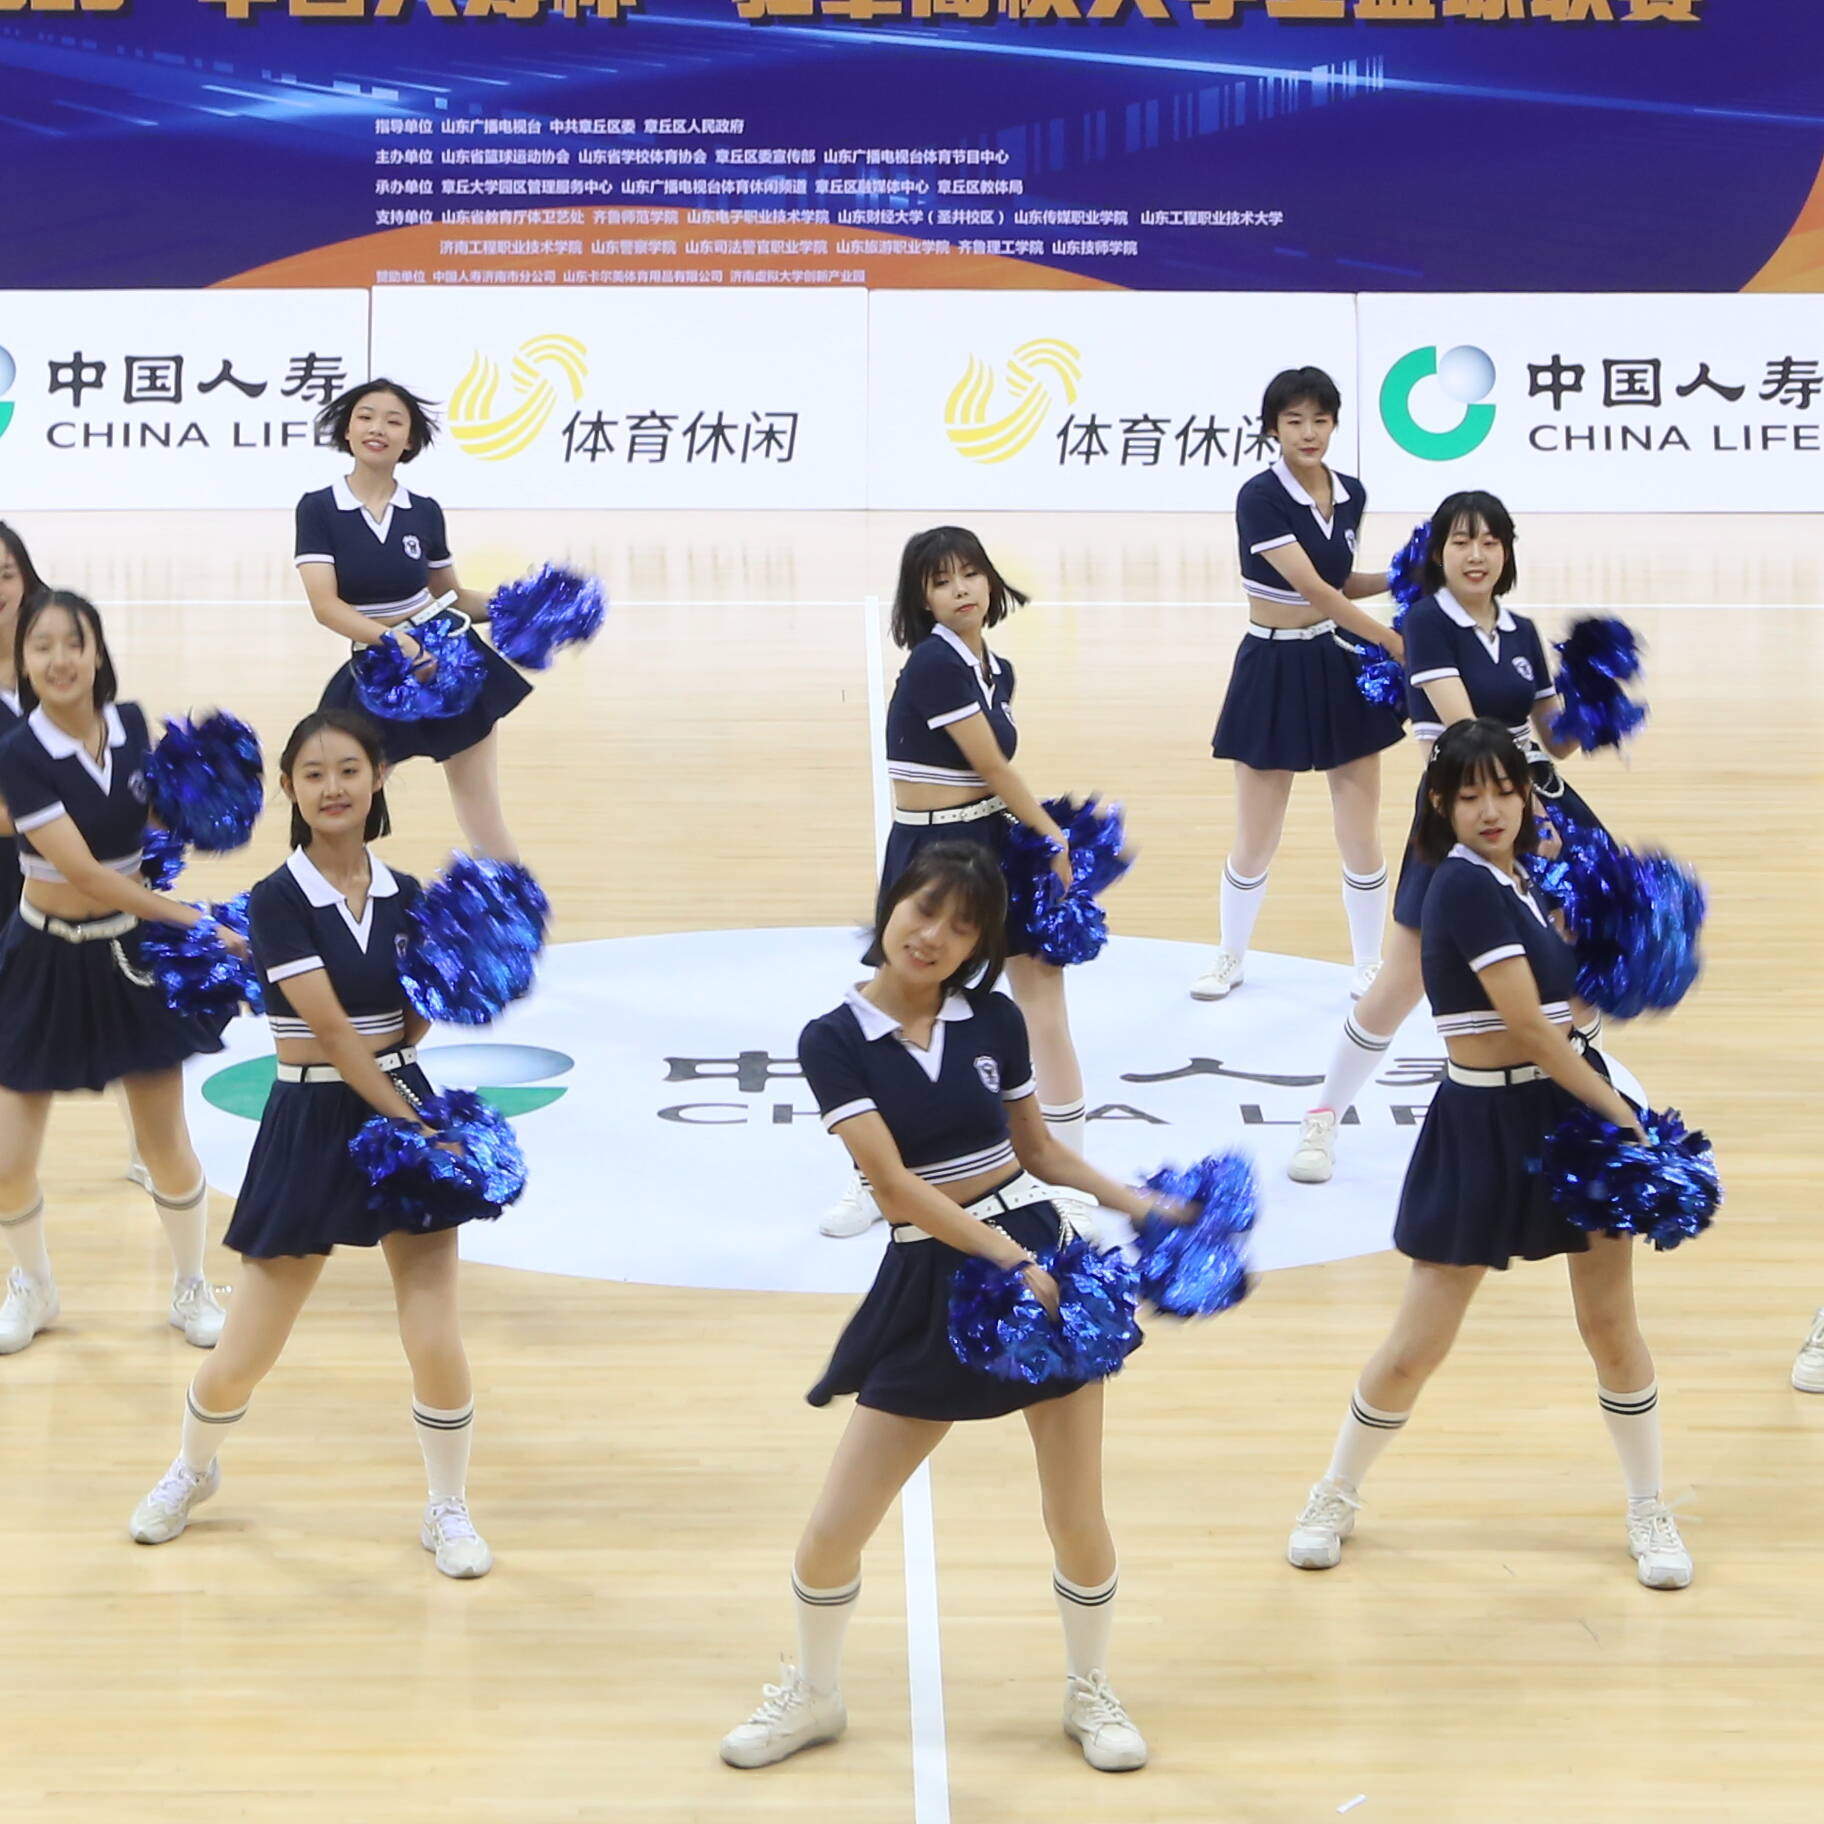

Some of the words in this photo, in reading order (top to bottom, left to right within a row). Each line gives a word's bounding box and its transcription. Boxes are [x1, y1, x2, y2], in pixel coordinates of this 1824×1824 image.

[375, 117, 434, 135] 指导单位
[441, 117, 542, 135] 山东广播电视台
[550, 117, 636, 135] 中共章丘区委
[643, 117, 745, 135] 章丘区人民政府
[375, 148, 434, 165] 主办单位
[441, 148, 570, 165] 山东省篮球运动协会
[578, 148, 707, 165] 山东省学校体育协会
[715, 148, 816, 165] 章丘区委宣传部
[823, 148, 1010, 165] 山东广播电视台体育节目中心
[375, 178, 434, 196] 承办单位
[441, 178, 613, 196] 章丘大学园区管理服务中心
[937, 178, 1024, 196] 章丘区教体局
[375, 209, 434, 226] 支持单位
[1014, 209, 1129, 226] 山东传媒职业学院
[1140, 209, 1284, 226] 山东工程职业技术大学
[958, 239, 1045, 256] 齐鲁理工学院
[1052, 239, 1138, 256] 山东技师学院
[47, 350, 348, 408] 中国人寿
[46, 420, 210, 448] CHINA
[561, 409, 800, 464] 体育休闲
[1527, 423, 1691, 452] CHINA
[1732, 423, 1822, 452] LIFE
